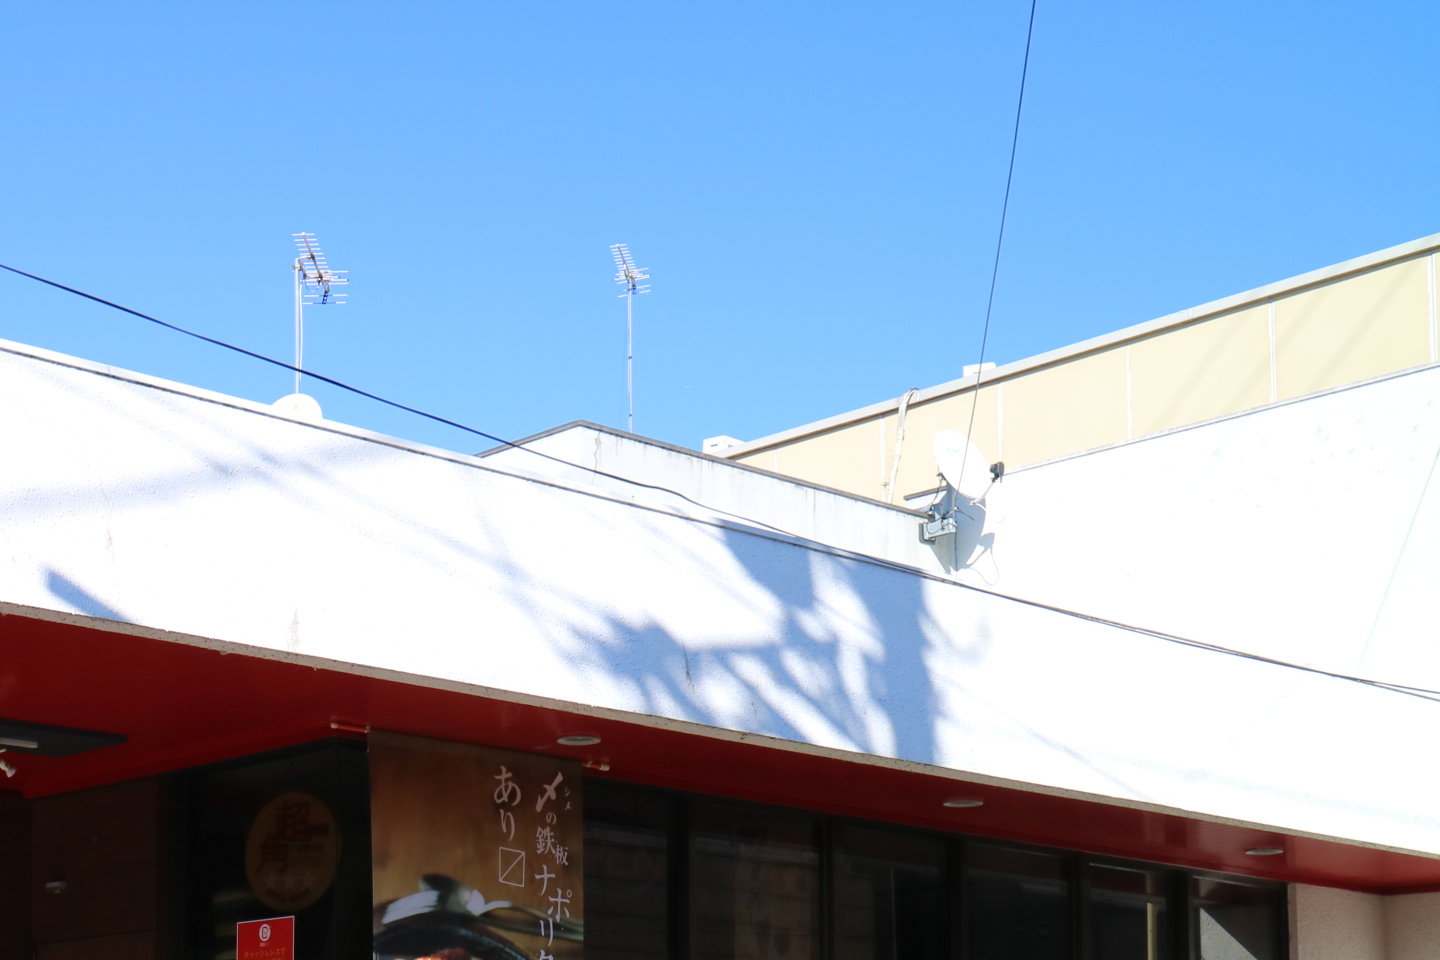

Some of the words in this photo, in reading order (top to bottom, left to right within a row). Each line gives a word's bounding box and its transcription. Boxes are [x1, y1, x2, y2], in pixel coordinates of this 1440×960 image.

[244, 948, 286, 958] キャッシュレスで
